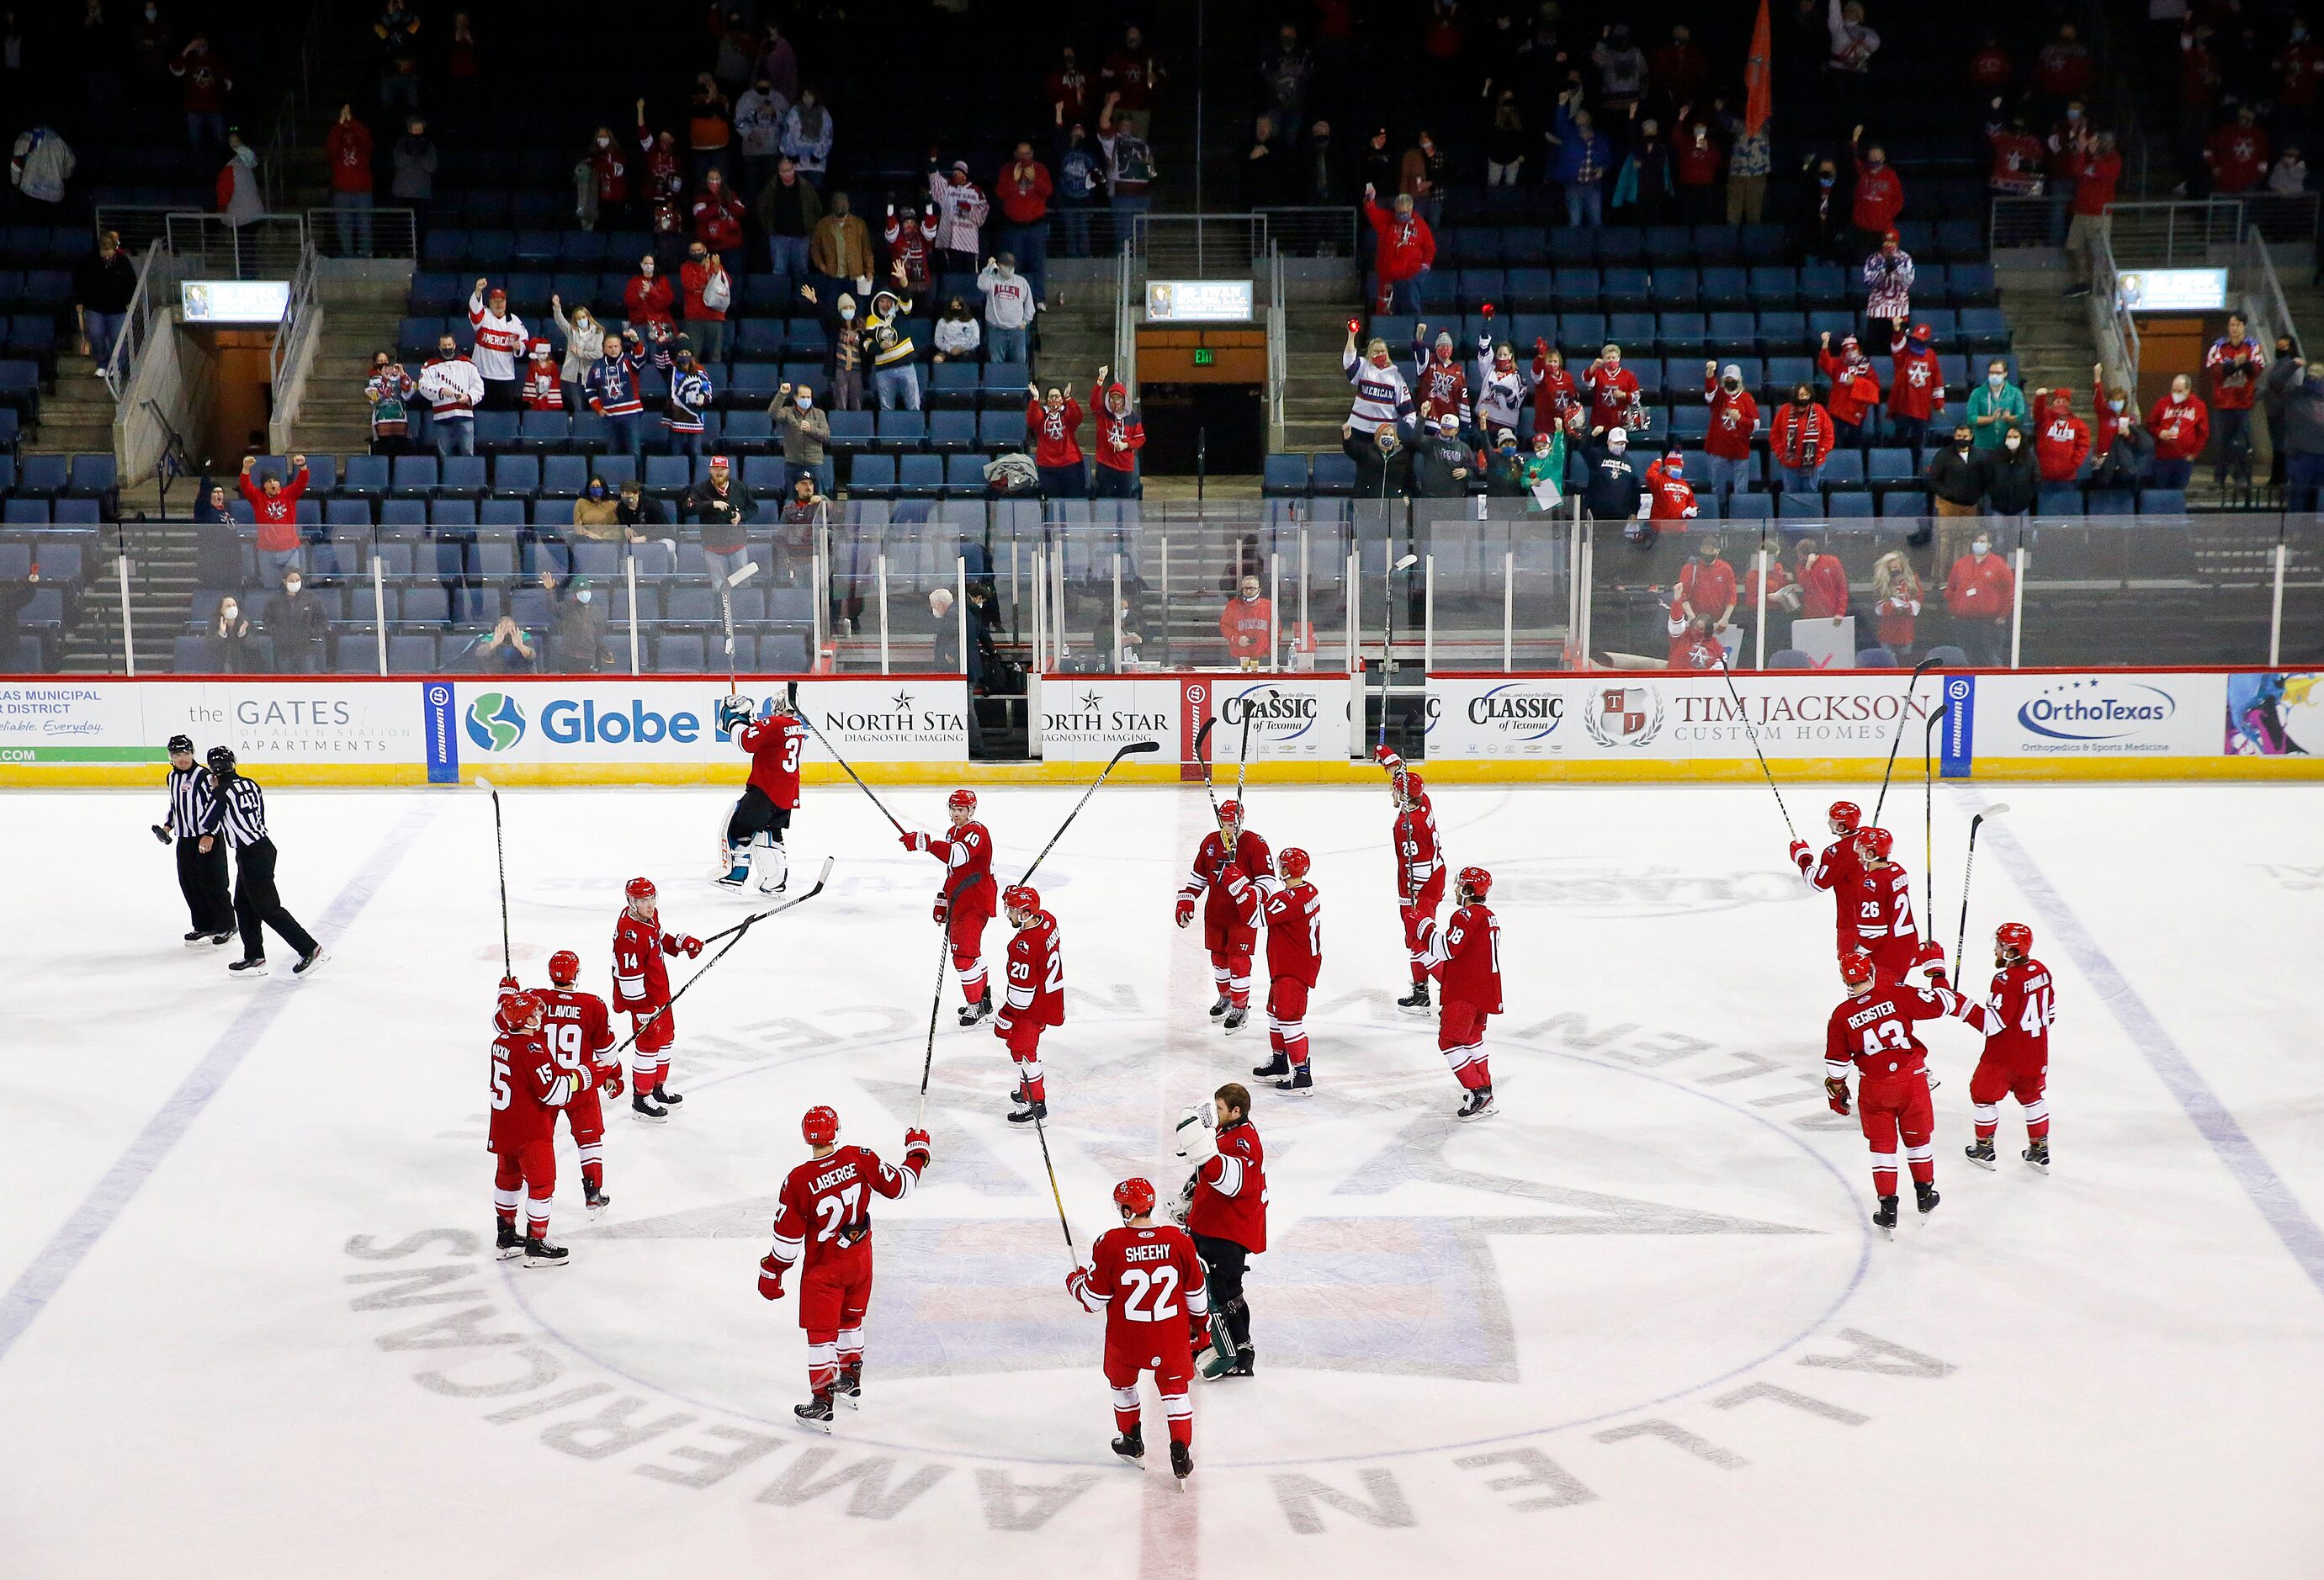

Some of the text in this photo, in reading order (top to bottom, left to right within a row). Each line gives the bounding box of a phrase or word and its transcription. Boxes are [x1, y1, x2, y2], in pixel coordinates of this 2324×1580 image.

[26, 691, 101, 701] MUNICIPAL
[8, 703, 71, 713] DISTRICT
[189, 700, 350, 725] the GATES
[1467, 697, 1563, 725] CLASSIC
[1675, 695, 1930, 726] TIM JACKSON
[2032, 699, 2164, 722] OrthoTexas
[43, 719, 104, 735] Everyday.
[541, 699, 700, 744] Globe
[825, 711, 914, 731] NORTH
[924, 712, 968, 731] STA
[1042, 712, 1170, 731] ORTH STAR
[1253, 720, 1302, 732] of Texoma
[1499, 720, 1548, 732] of Texoma
[436, 707, 448, 764] WARRIOR
[844, 734, 963, 743] DIAGNOSTIC IMAGING
[1042, 734, 1152, 743] IAGNOSTIC IMAGING
[1674, 725, 1886, 740] CUSTOM HOMES
[241, 740, 386, 751] APARTMENTS
[782, 737, 799, 773] 3
[2022, 743, 2081, 753] Orthopedics
[2092, 743, 2123, 753] Sports
[2125, 743, 2169, 751] Medicine
[1267, 898, 1287, 915] 17
[1860, 901, 1880, 918] 26
[1894, 893, 1915, 938] 2
[1447, 925, 1465, 945] 18
[623, 952, 638, 969] 14
[1011, 961, 1029, 980] 20
[1045, 950, 1064, 994] 2
[548, 1005, 581, 1020] LAVOIE
[1847, 1000, 1897, 1030] REGISTER
[544, 1023, 583, 1070] 19
[1862, 1020, 1912, 1057] 43
[535, 1063, 552, 1084] 15
[491, 1059, 512, 1111] 5
[808, 1163, 857, 1195] LABERGE
[815, 1182, 862, 1243] 27
[1126, 1243, 1170, 1263] SHEEHY
[1121, 1265, 1179, 1322] 22
[343, 1227, 1093, 1531] AMERICANS
